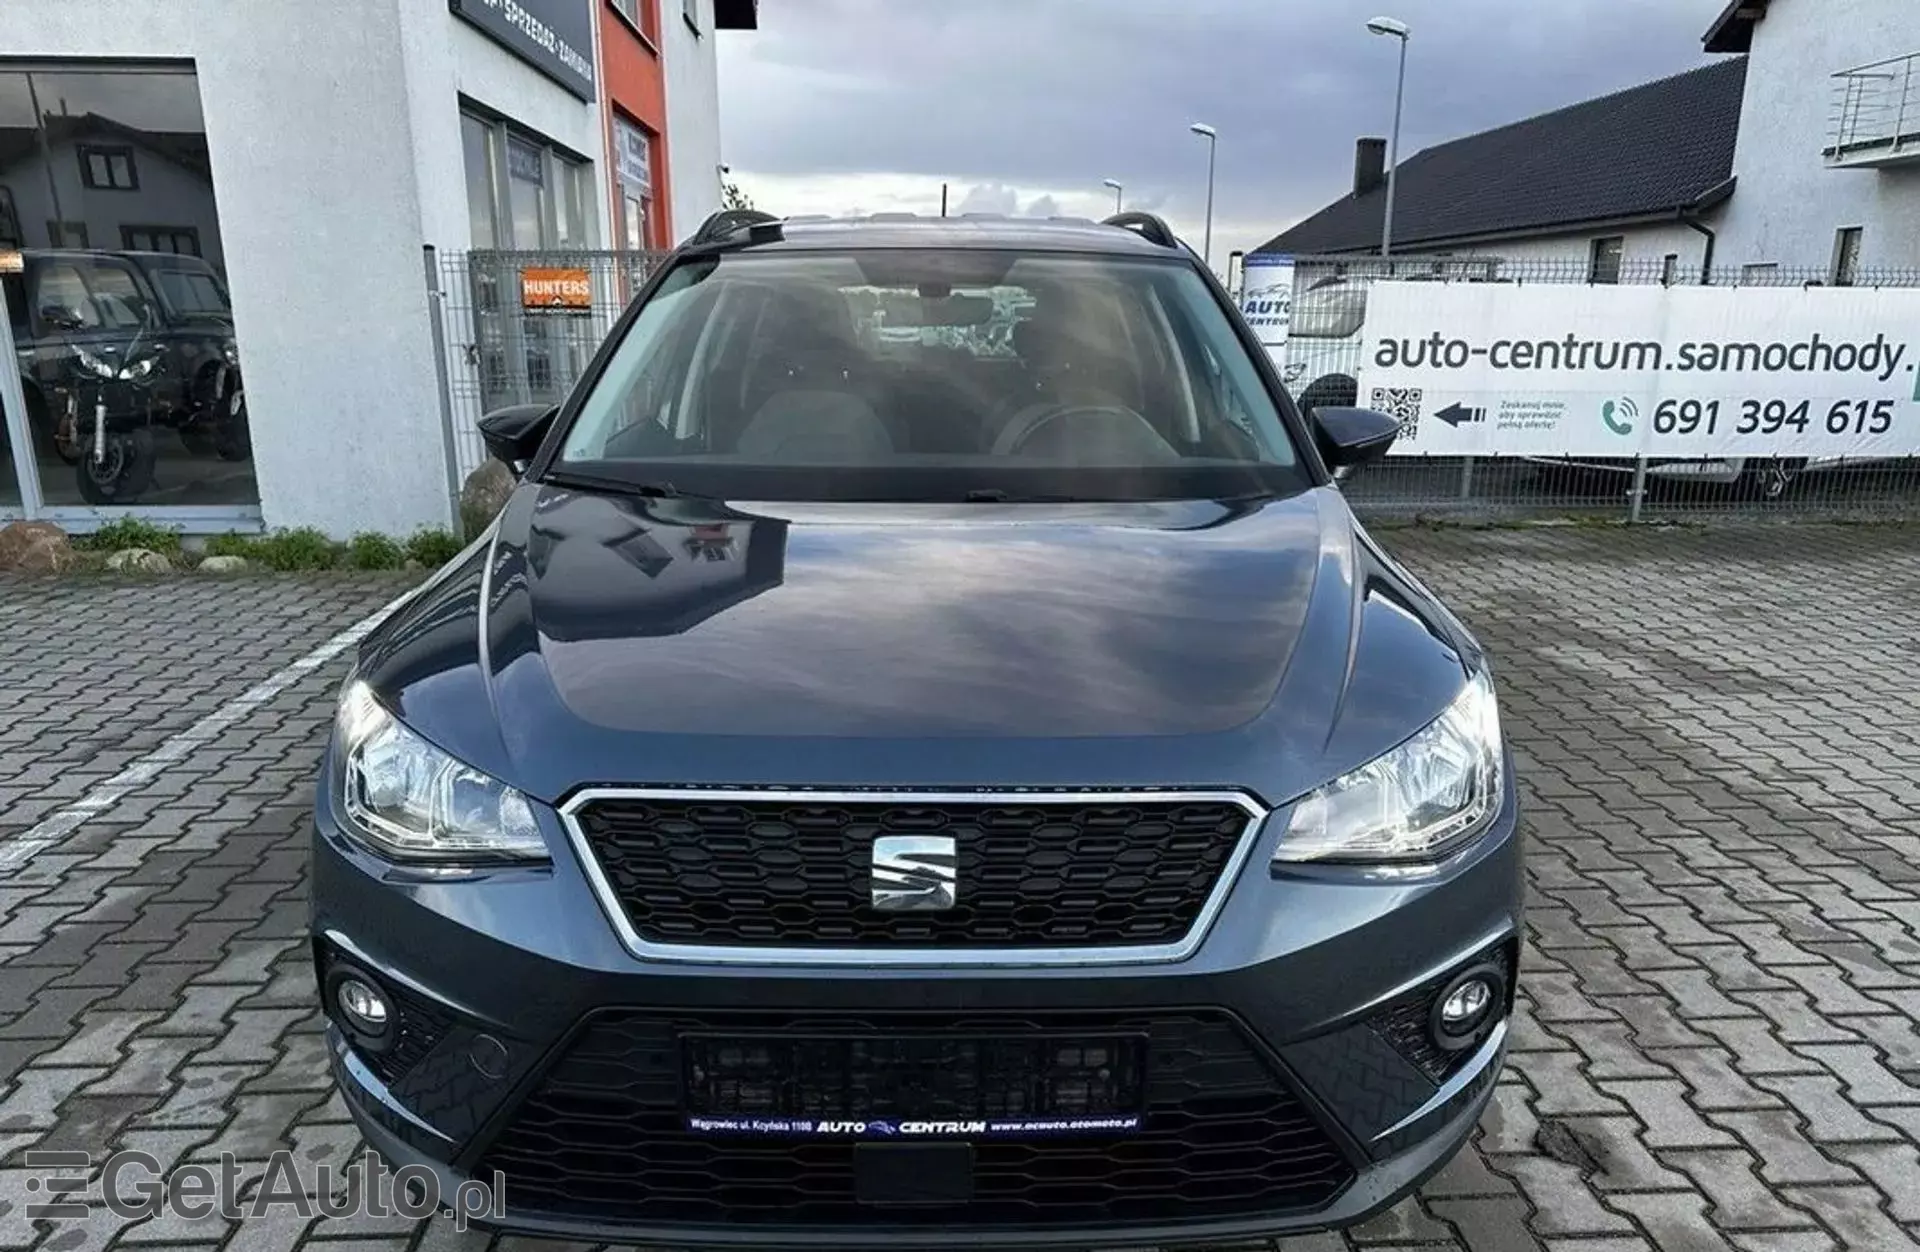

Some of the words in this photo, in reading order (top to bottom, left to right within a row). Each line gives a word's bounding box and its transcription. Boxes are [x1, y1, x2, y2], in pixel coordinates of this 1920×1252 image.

[523, 279, 590, 296] HUNTERS
[1653, 399, 1720, 436] 691
[1736, 399, 1811, 435] 394
[1826, 399, 1895, 435] 615
[817, 1121, 866, 1133] AUTO
[899, 1121, 986, 1133] CENTRUM
